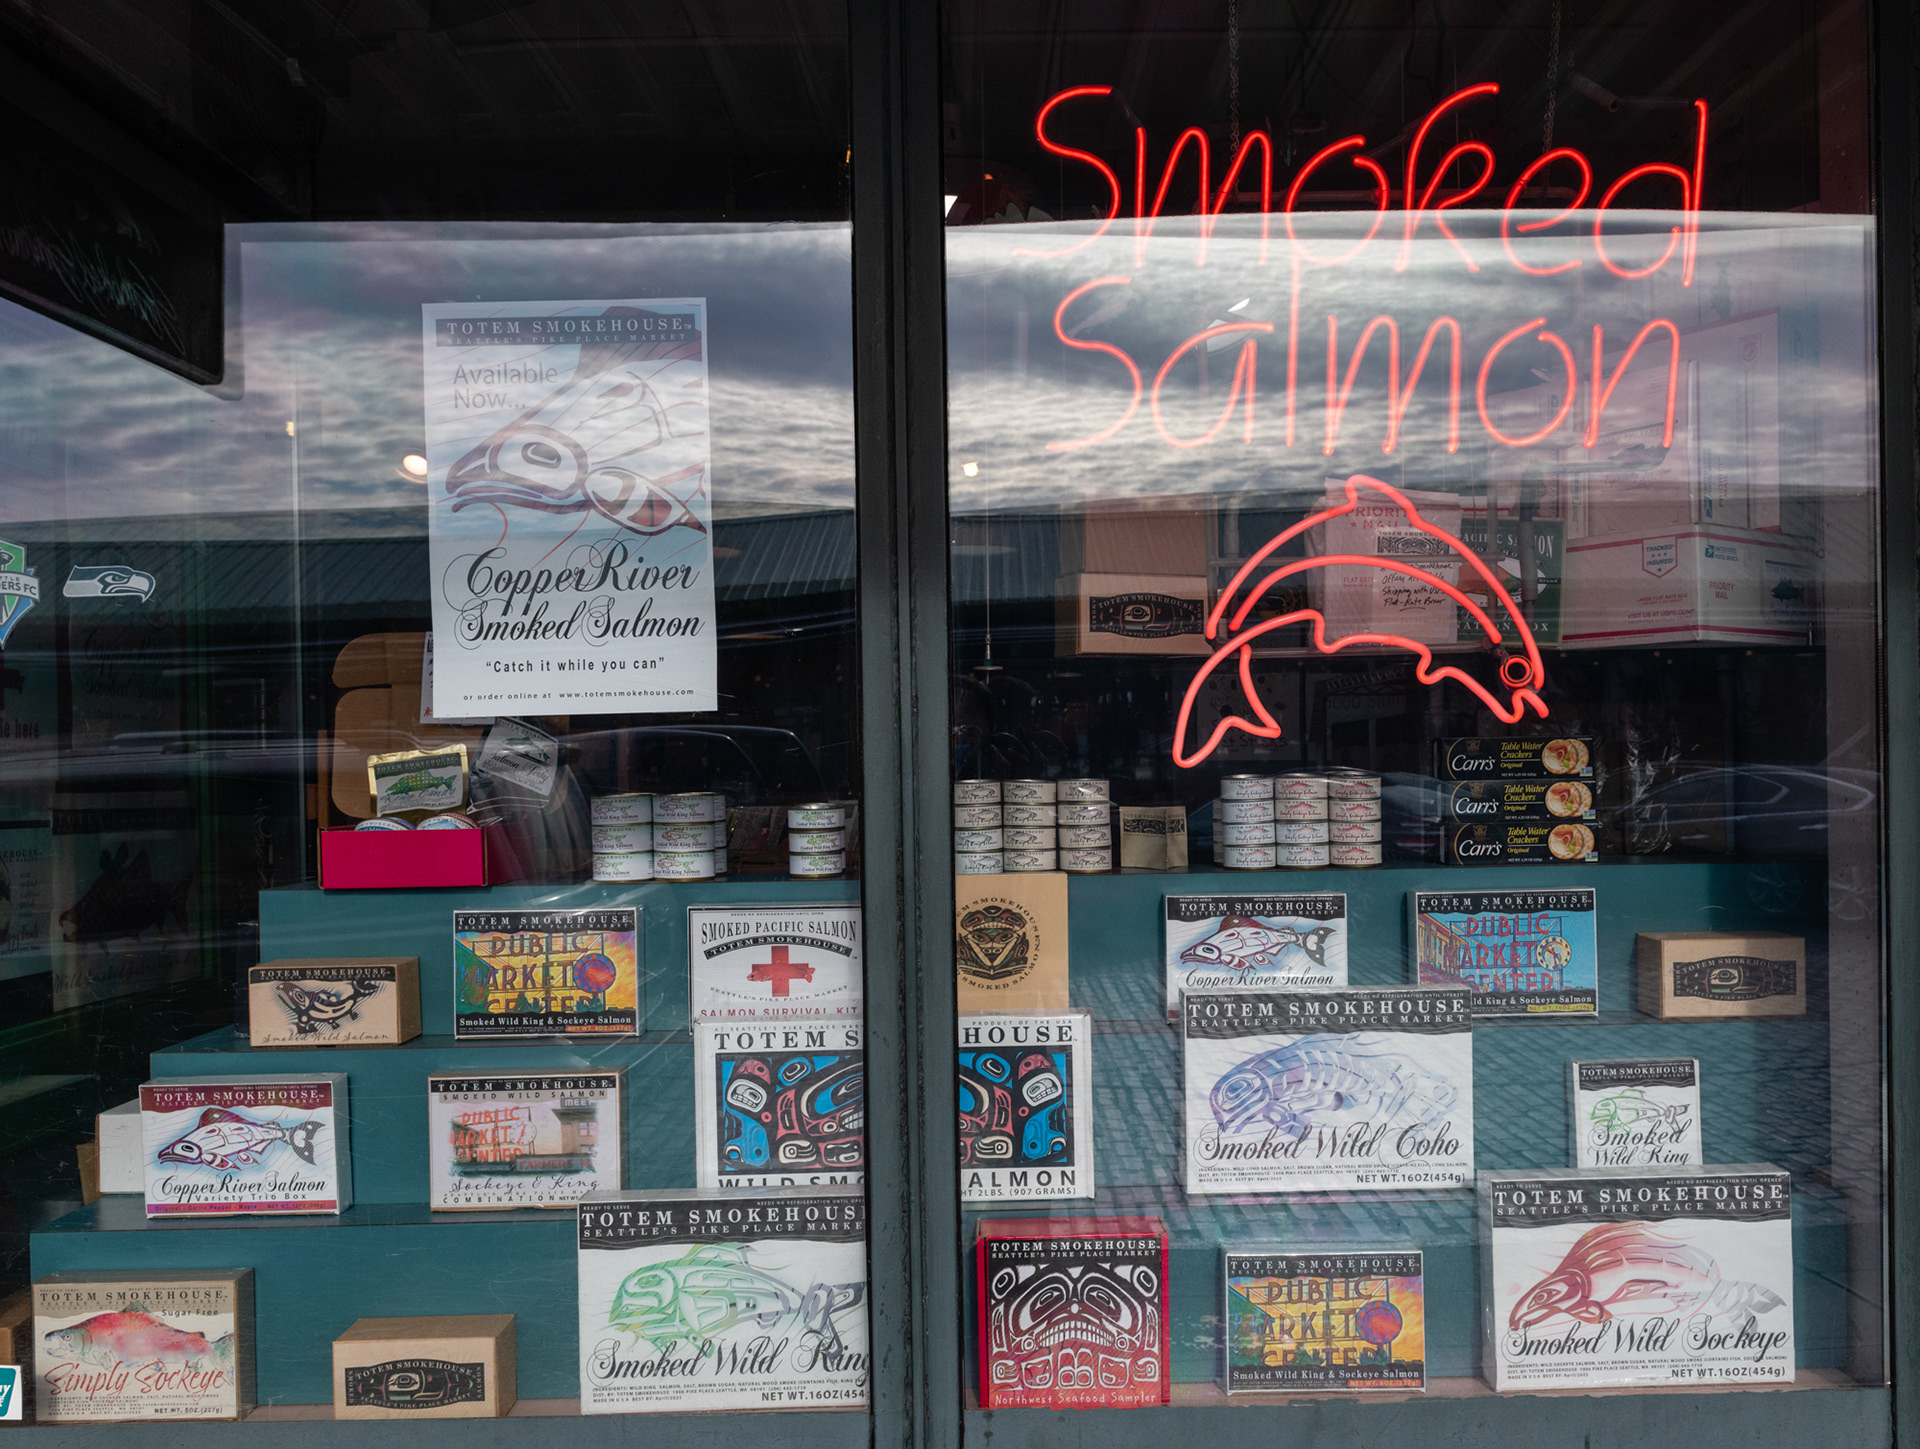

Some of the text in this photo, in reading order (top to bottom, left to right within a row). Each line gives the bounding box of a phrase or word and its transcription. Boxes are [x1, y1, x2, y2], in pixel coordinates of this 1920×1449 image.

[1013, 83, 1707, 287] Smoked
[447, 321, 521, 335] TOTEM
[447, 337, 522, 345] SEATTLE'S
[576, 335, 620, 343] PLACE
[630, 333, 686, 341] MARKET
[1045, 262, 1681, 455] Salmon
[453, 362, 558, 384] Available
[453, 388, 526, 409] Now...
[442, 538, 700, 616] Copper River
[24, 583, 36, 596] FC
[1714, 591, 1729, 600] MAIL
[454, 595, 705, 650] Smoked Salmon
[541, 660, 550, 672] it
[558, 659, 594, 671] while
[602, 659, 626, 673] you
[507, 692, 538, 700] online
[559, 688, 694, 699] www.totemsmokehouse.com
[1501, 742, 1520, 750] Table
[1500, 751, 1532, 759] Crackers
[1451, 755, 1495, 771] Carr's
[1504, 785, 1524, 793] Table
[1504, 793, 1536, 802] Crackers
[1455, 797, 1499, 814] Carr's
[1508, 827, 1528, 835] Table
[1507, 836, 1539, 844] Crackers
[1459, 840, 1502, 856] Carr's
[1180, 903, 1228, 911] TOTEM
[1420, 898, 1472, 907] TOTEM
[458, 917, 510, 925] TOTEM
[1466, 913, 1550, 937] PUBLIC
[701, 921, 856, 944] SMOKED PACIFIC SALMON
[711, 936, 847, 955] TOTEM SMOKEHOUSE
[1178, 966, 1336, 989] Copper River Salmon
[814, 985, 848, 998] MARKET
[1486, 996, 1507, 1006] King
[1510, 996, 1516, 1004] &
[1520, 996, 1555, 1005] Sockeye
[1188, 1002, 1274, 1018] TOTEM
[459, 1016, 631, 1027] Smoked Wild King & Sockeye Salmon
[1190, 1014, 1464, 1028] SEATTLE'S PIKE PLACE MARKET
[714, 1030, 826, 1050] TOTEM
[438, 1082, 493, 1092] TOTEM
[154, 1092, 206, 1102] TOTEM
[443, 1093, 496, 1101] SMOKED
[552, 1090, 605, 1098] SALMON
[1588, 1119, 1692, 1151] Smoked
[1193, 1121, 1463, 1170] Smoked Wild Coho
[1588, 1143, 1692, 1166] Wild King
[451, 1174, 600, 1195] Sockeye & King
[1356, 1174, 1378, 1184] NET
[152, 1170, 328, 1203] Copper River Salmon
[978, 1188, 1076, 1197] 2LBS. (907 GRAMS)
[196, 1194, 244, 1203] Variety
[1494, 1189, 1584, 1206] TOTEM
[1497, 1200, 1783, 1216] SEATTLE'S PIKE PLACE MARKET
[581, 1209, 674, 1228] TOTEM
[584, 1223, 796, 1238] SEATTLE'S PIKE PLACE
[991, 1242, 1044, 1251] TOTEM
[1231, 1261, 1287, 1270] TOTEM
[40, 1292, 98, 1301] TOTEM
[161, 1308, 219, 1318] Sugar Free
[1501, 1312, 1791, 1364] Smoked Wild Sockeye
[586, 1336, 789, 1387] Smoked Wild
[355, 1364, 393, 1380] TOTEM
[1233, 1369, 1419, 1381] Smoked Wild King & Sockeye Salmon
[1671, 1368, 1693, 1378] NET
[44, 1360, 226, 1403] Simply Sockeye
[995, 1392, 1156, 1406] Northwest Seafood Sampler
